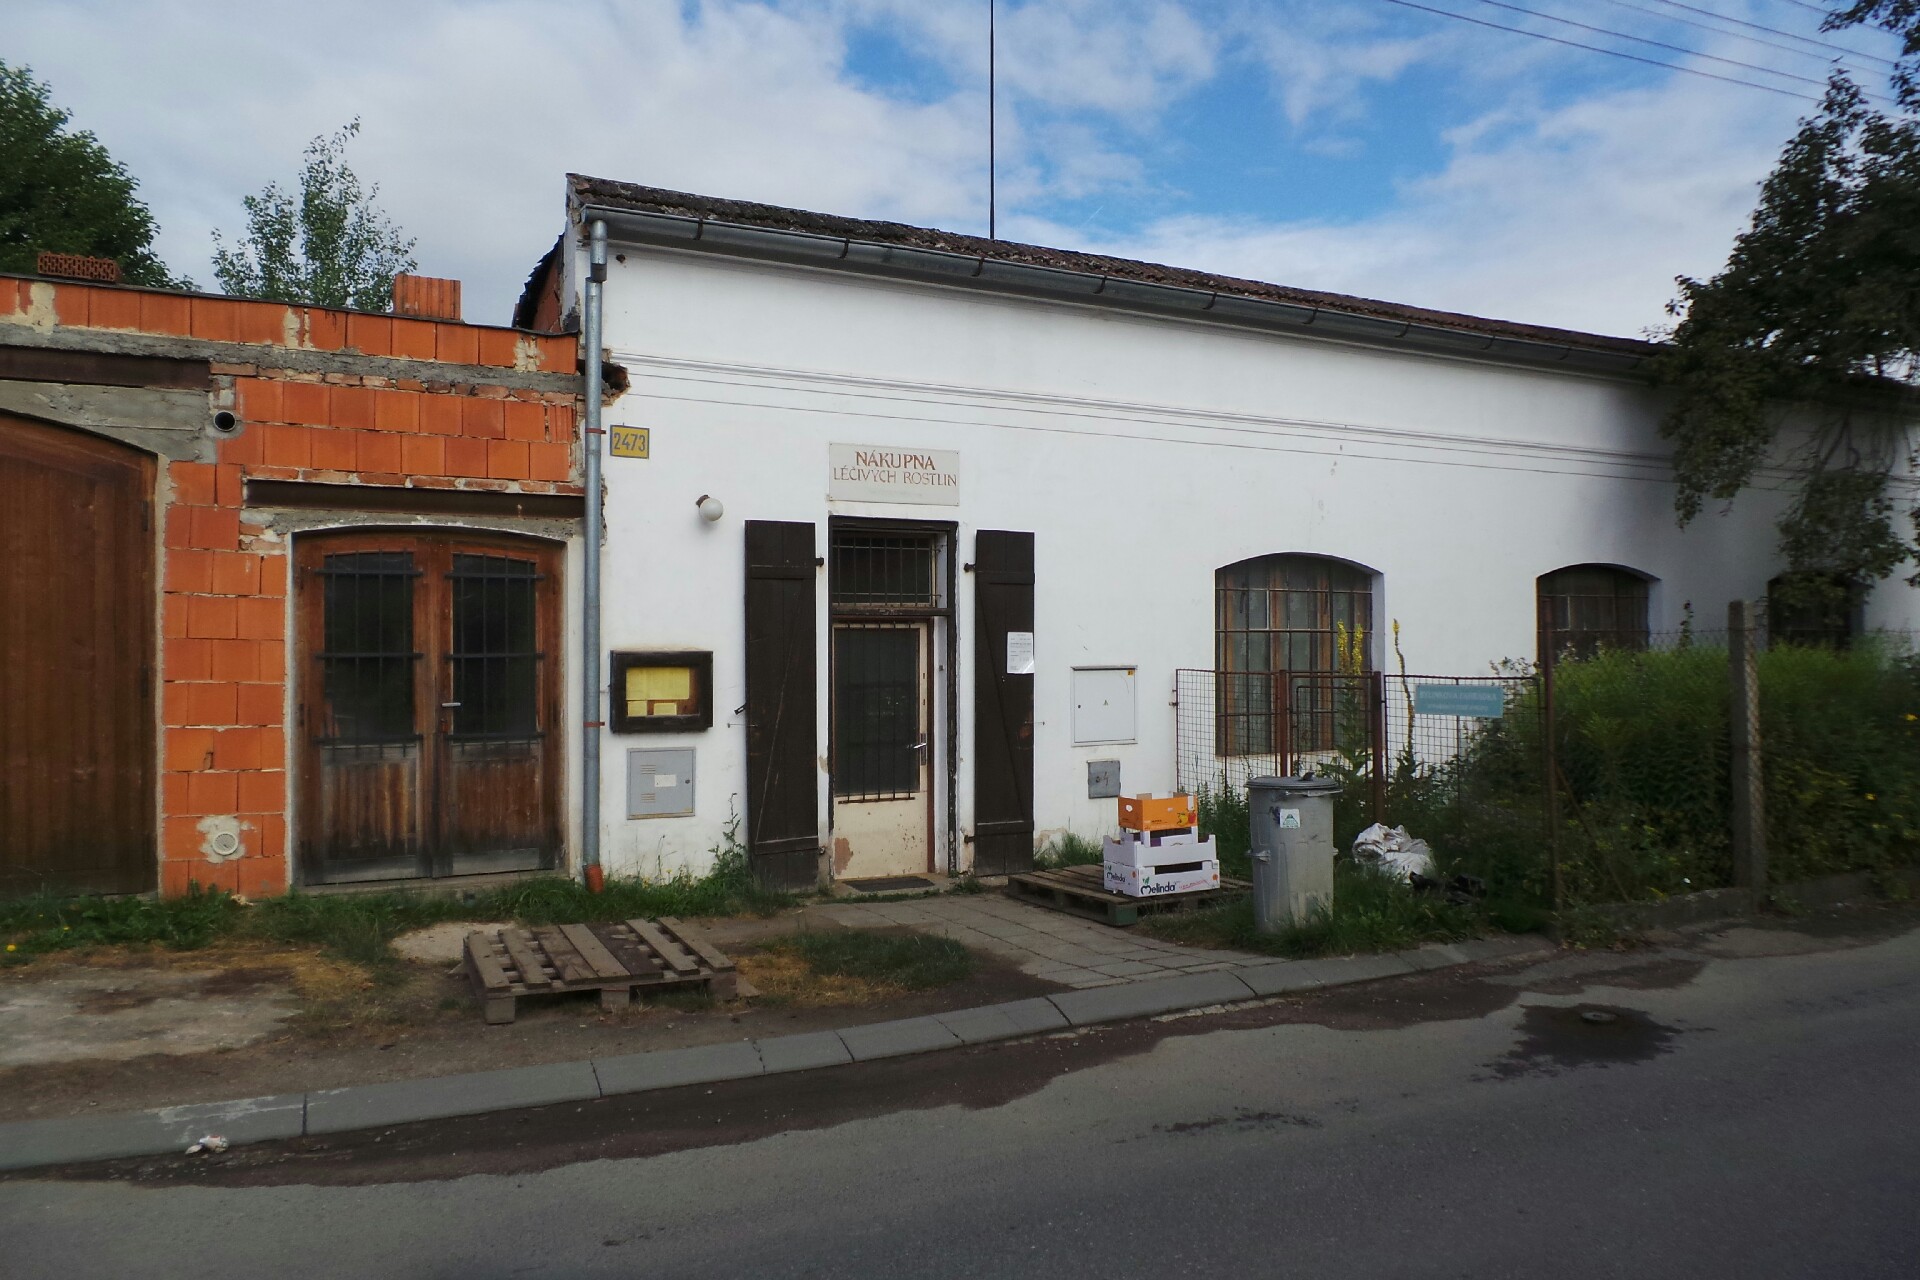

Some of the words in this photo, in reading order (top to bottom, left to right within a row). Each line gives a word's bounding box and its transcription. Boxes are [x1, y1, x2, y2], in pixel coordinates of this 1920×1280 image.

[613, 432, 646, 452] 2473
[855, 450, 936, 471] NÁKUPNA
[903, 471, 957, 487] ROSTLIN
[1140, 881, 1176, 895] Melinda
